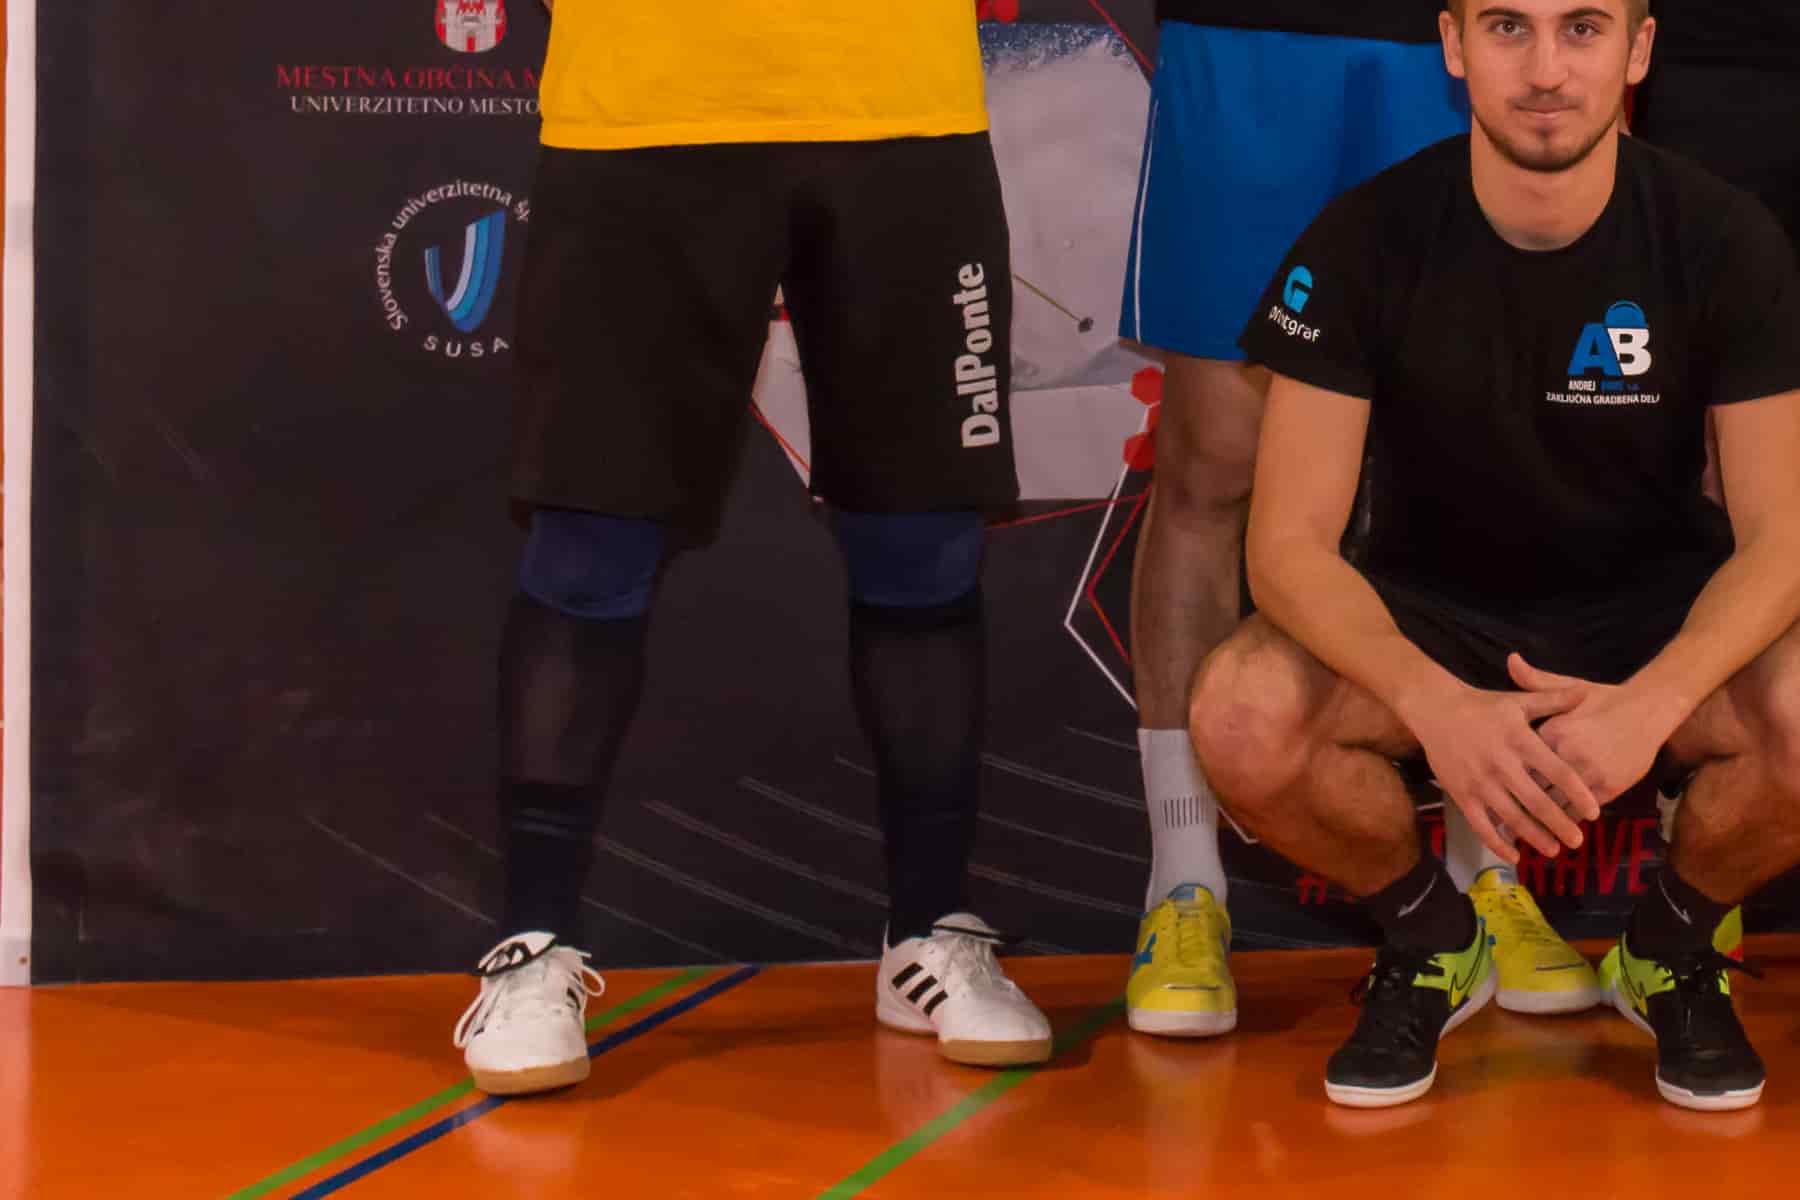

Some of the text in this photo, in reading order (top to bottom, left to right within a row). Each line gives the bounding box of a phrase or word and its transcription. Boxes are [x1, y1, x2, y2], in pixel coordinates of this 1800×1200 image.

[276, 64, 397, 89] MESTNA
[404, 62, 516, 89] OBČINA
[291, 96, 541, 115] UNIVERZITETNO MESTO
[391, 178, 513, 231] univerzitetna
[375, 231, 409, 332] Slovenska
[423, 335, 511, 358] SUSA
[953, 263, 1001, 449] DalPonte
[1567, 322, 1653, 377] AB
